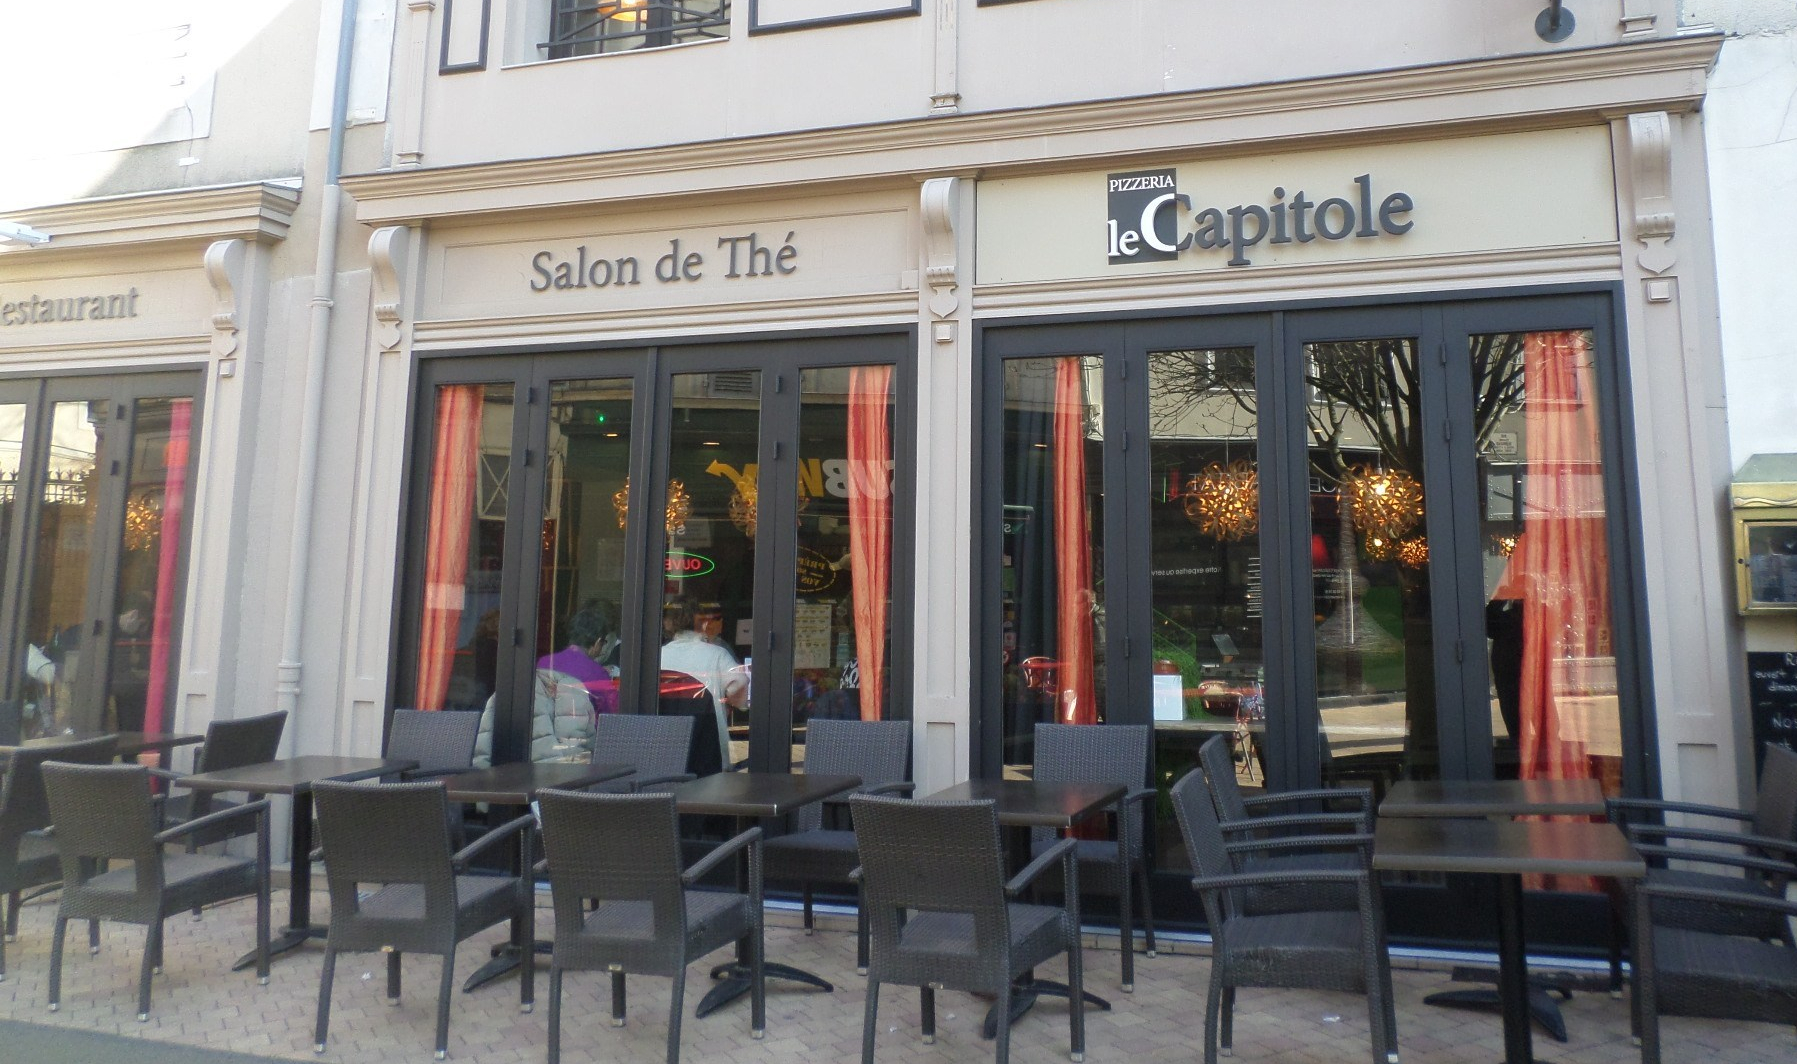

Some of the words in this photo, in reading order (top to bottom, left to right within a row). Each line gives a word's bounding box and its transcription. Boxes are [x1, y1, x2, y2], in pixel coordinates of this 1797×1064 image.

[1109, 175, 1175, 193] PIZZERIA
[1107, 219, 1140, 257] le
[1140, 173, 1415, 267] Capitole
[530, 245, 640, 292] Salon
[655, 238, 703, 283] de
[717, 230, 798, 279] Thé
[0, 287, 139, 326] estaurant
